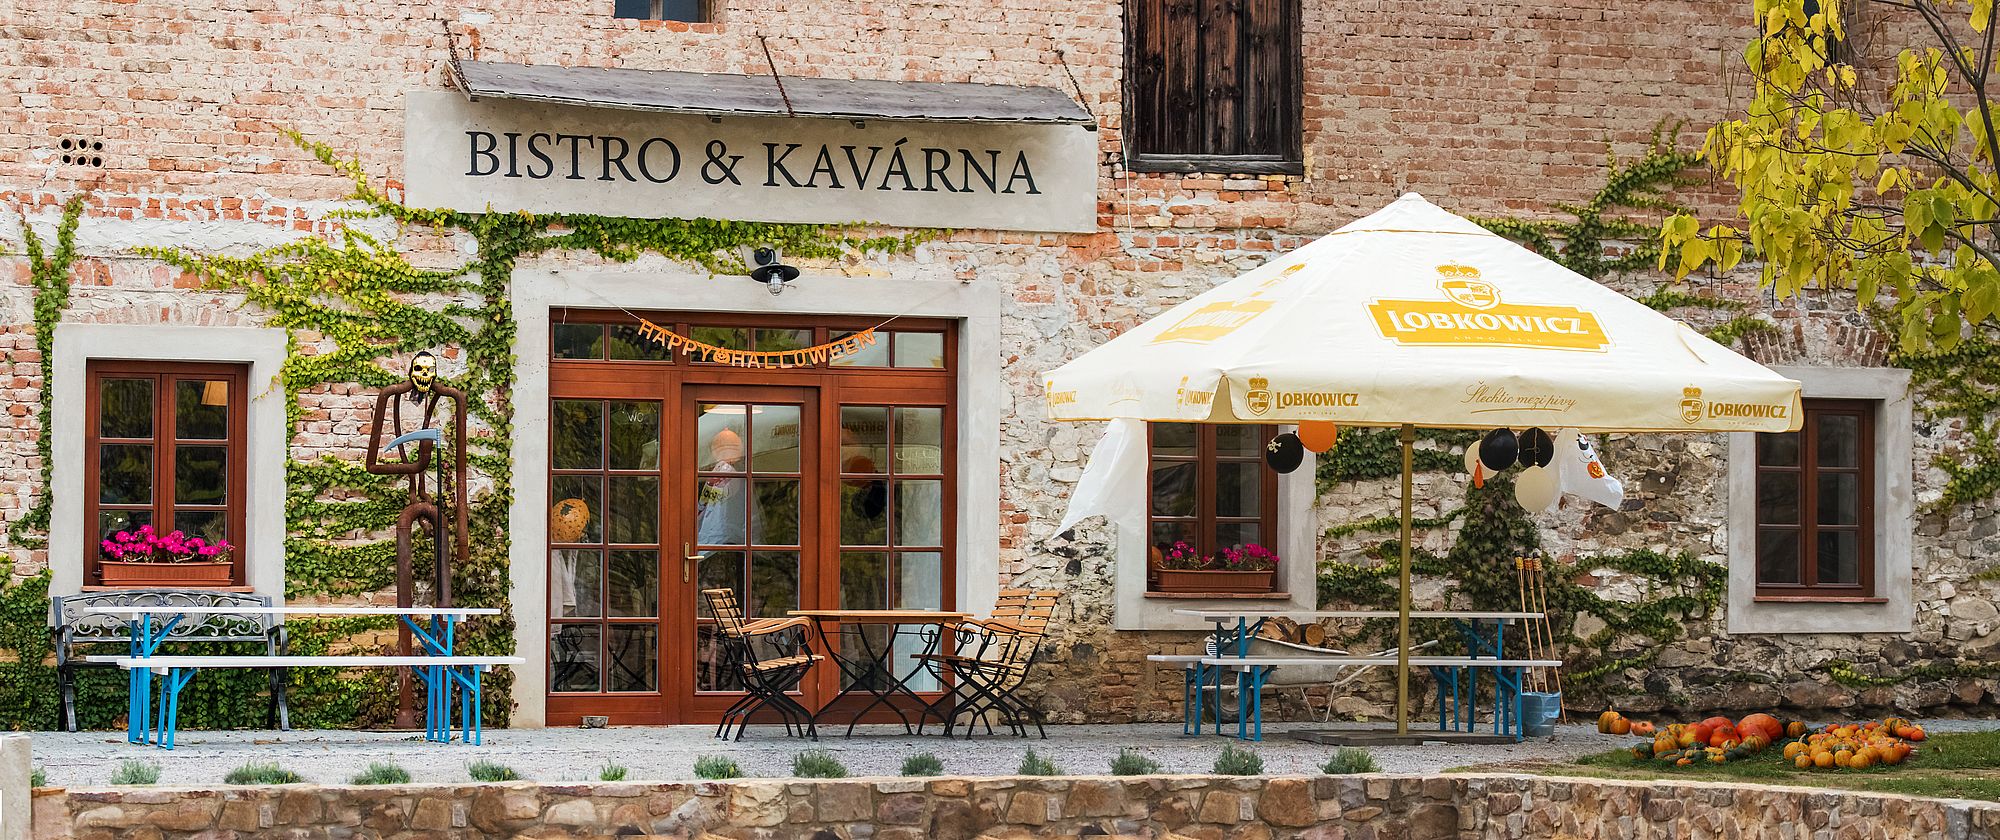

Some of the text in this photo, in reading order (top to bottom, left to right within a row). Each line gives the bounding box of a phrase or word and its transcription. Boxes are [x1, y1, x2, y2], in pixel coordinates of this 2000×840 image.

[465, 130, 1042, 195] BISTRO & KAVÁRNA
[1386, 309, 1590, 335] LOBKOWICZ
[637, 319, 877, 370] HAPPY HALLOWEEN
[1276, 392, 1359, 409] LOBKOWICZ
[1460, 380, 1514, 404] Šlechtic
[1707, 401, 1787, 419] LOBKOWICZ
